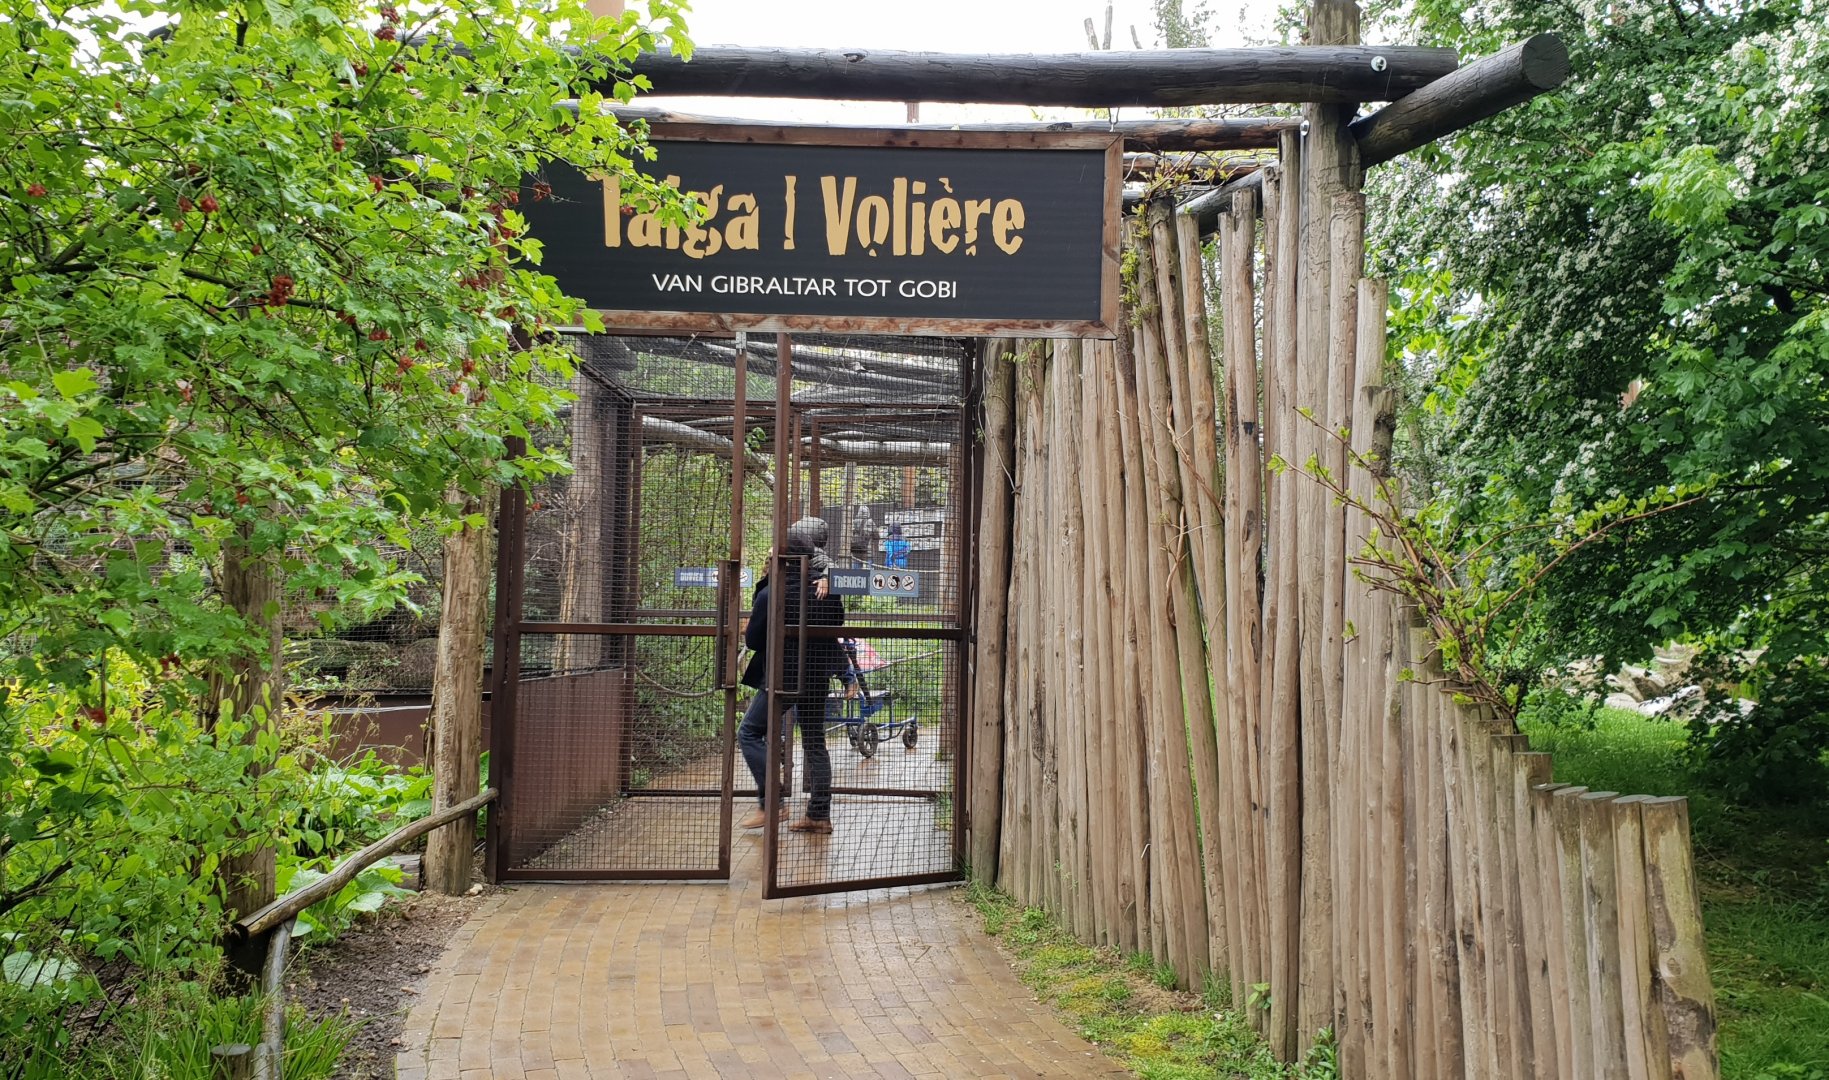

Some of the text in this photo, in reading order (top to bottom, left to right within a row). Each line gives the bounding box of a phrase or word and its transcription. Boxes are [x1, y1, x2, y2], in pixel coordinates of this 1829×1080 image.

[820, 175, 1026, 257] Volière
[652, 273, 957, 298] VAN GIBRALTAR TOT GOBI
[833, 575, 867, 589] TREKKEN
